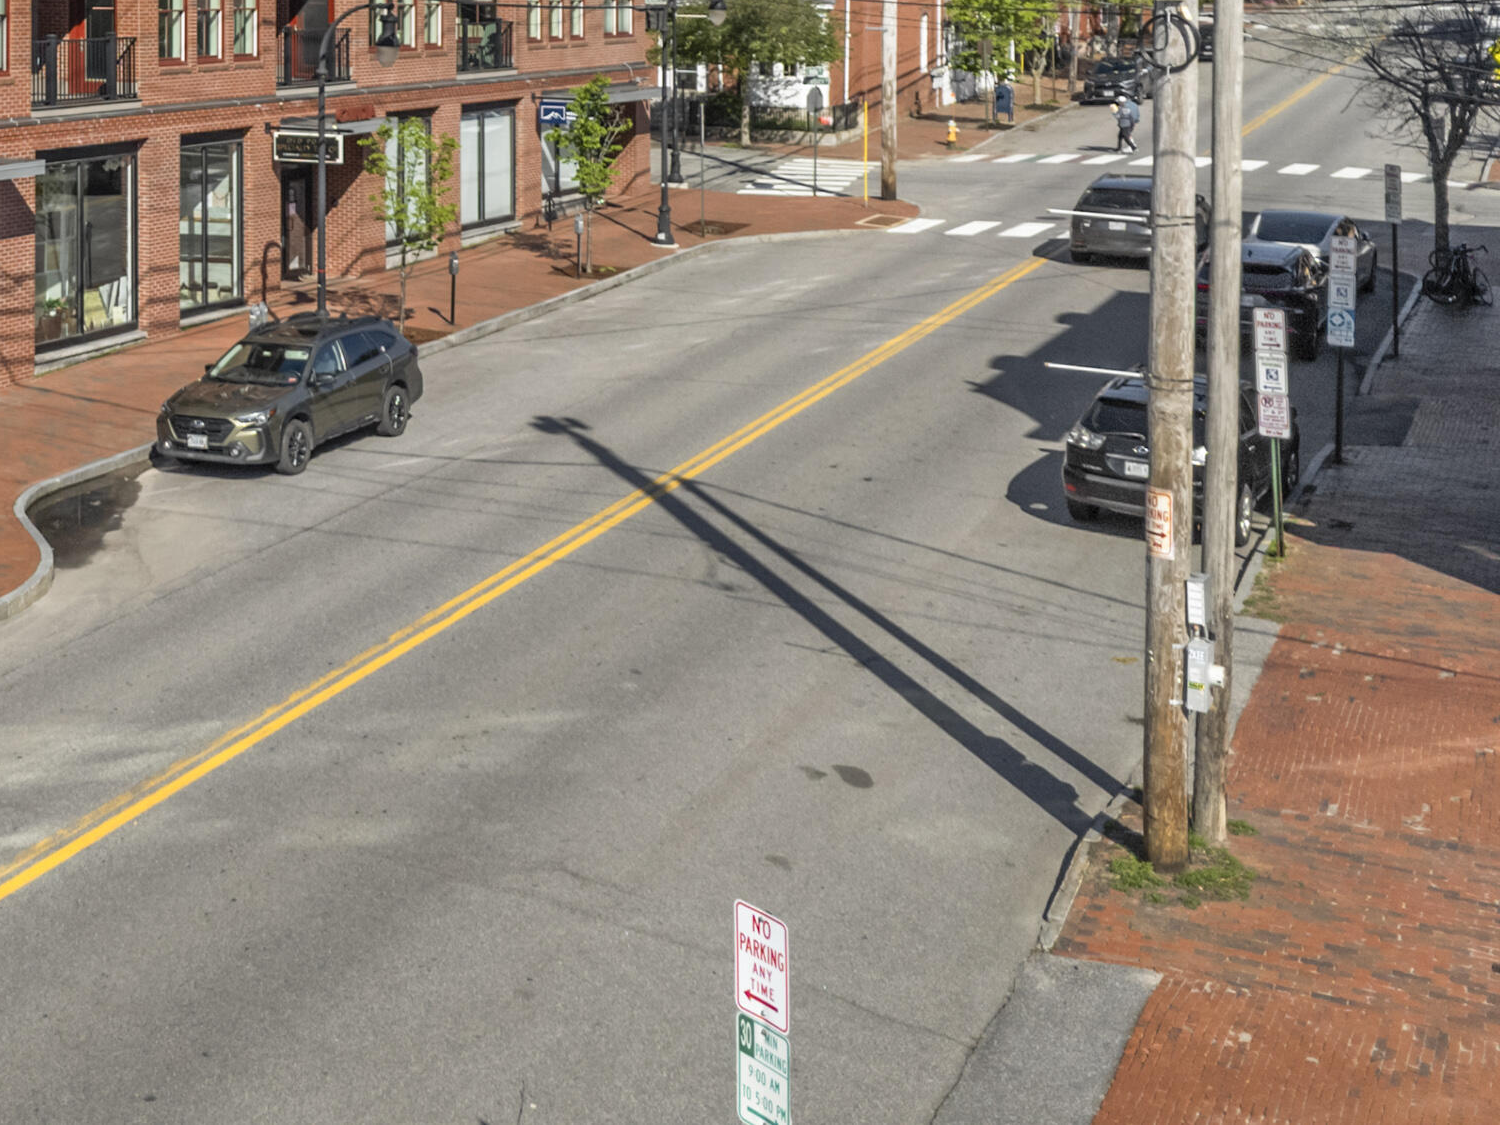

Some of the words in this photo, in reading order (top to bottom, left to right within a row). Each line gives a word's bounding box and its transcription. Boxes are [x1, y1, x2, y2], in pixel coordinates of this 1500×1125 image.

[1255, 321, 1284, 330] PARKING
[1263, 311, 1275, 320] NO
[752, 914, 771, 940] NO
[739, 931, 785, 972] PARKING
[753, 962, 772, 981] ANY
[750, 976, 775, 1002] TIME
[740, 1018, 753, 1050] 30
[764, 1033, 778, 1051] MIN
[755, 1042, 787, 1074] PARKING
[769, 1077, 781, 1095] AM
[742, 1083, 752, 1100] TO
[776, 1104, 788, 1124] PM
